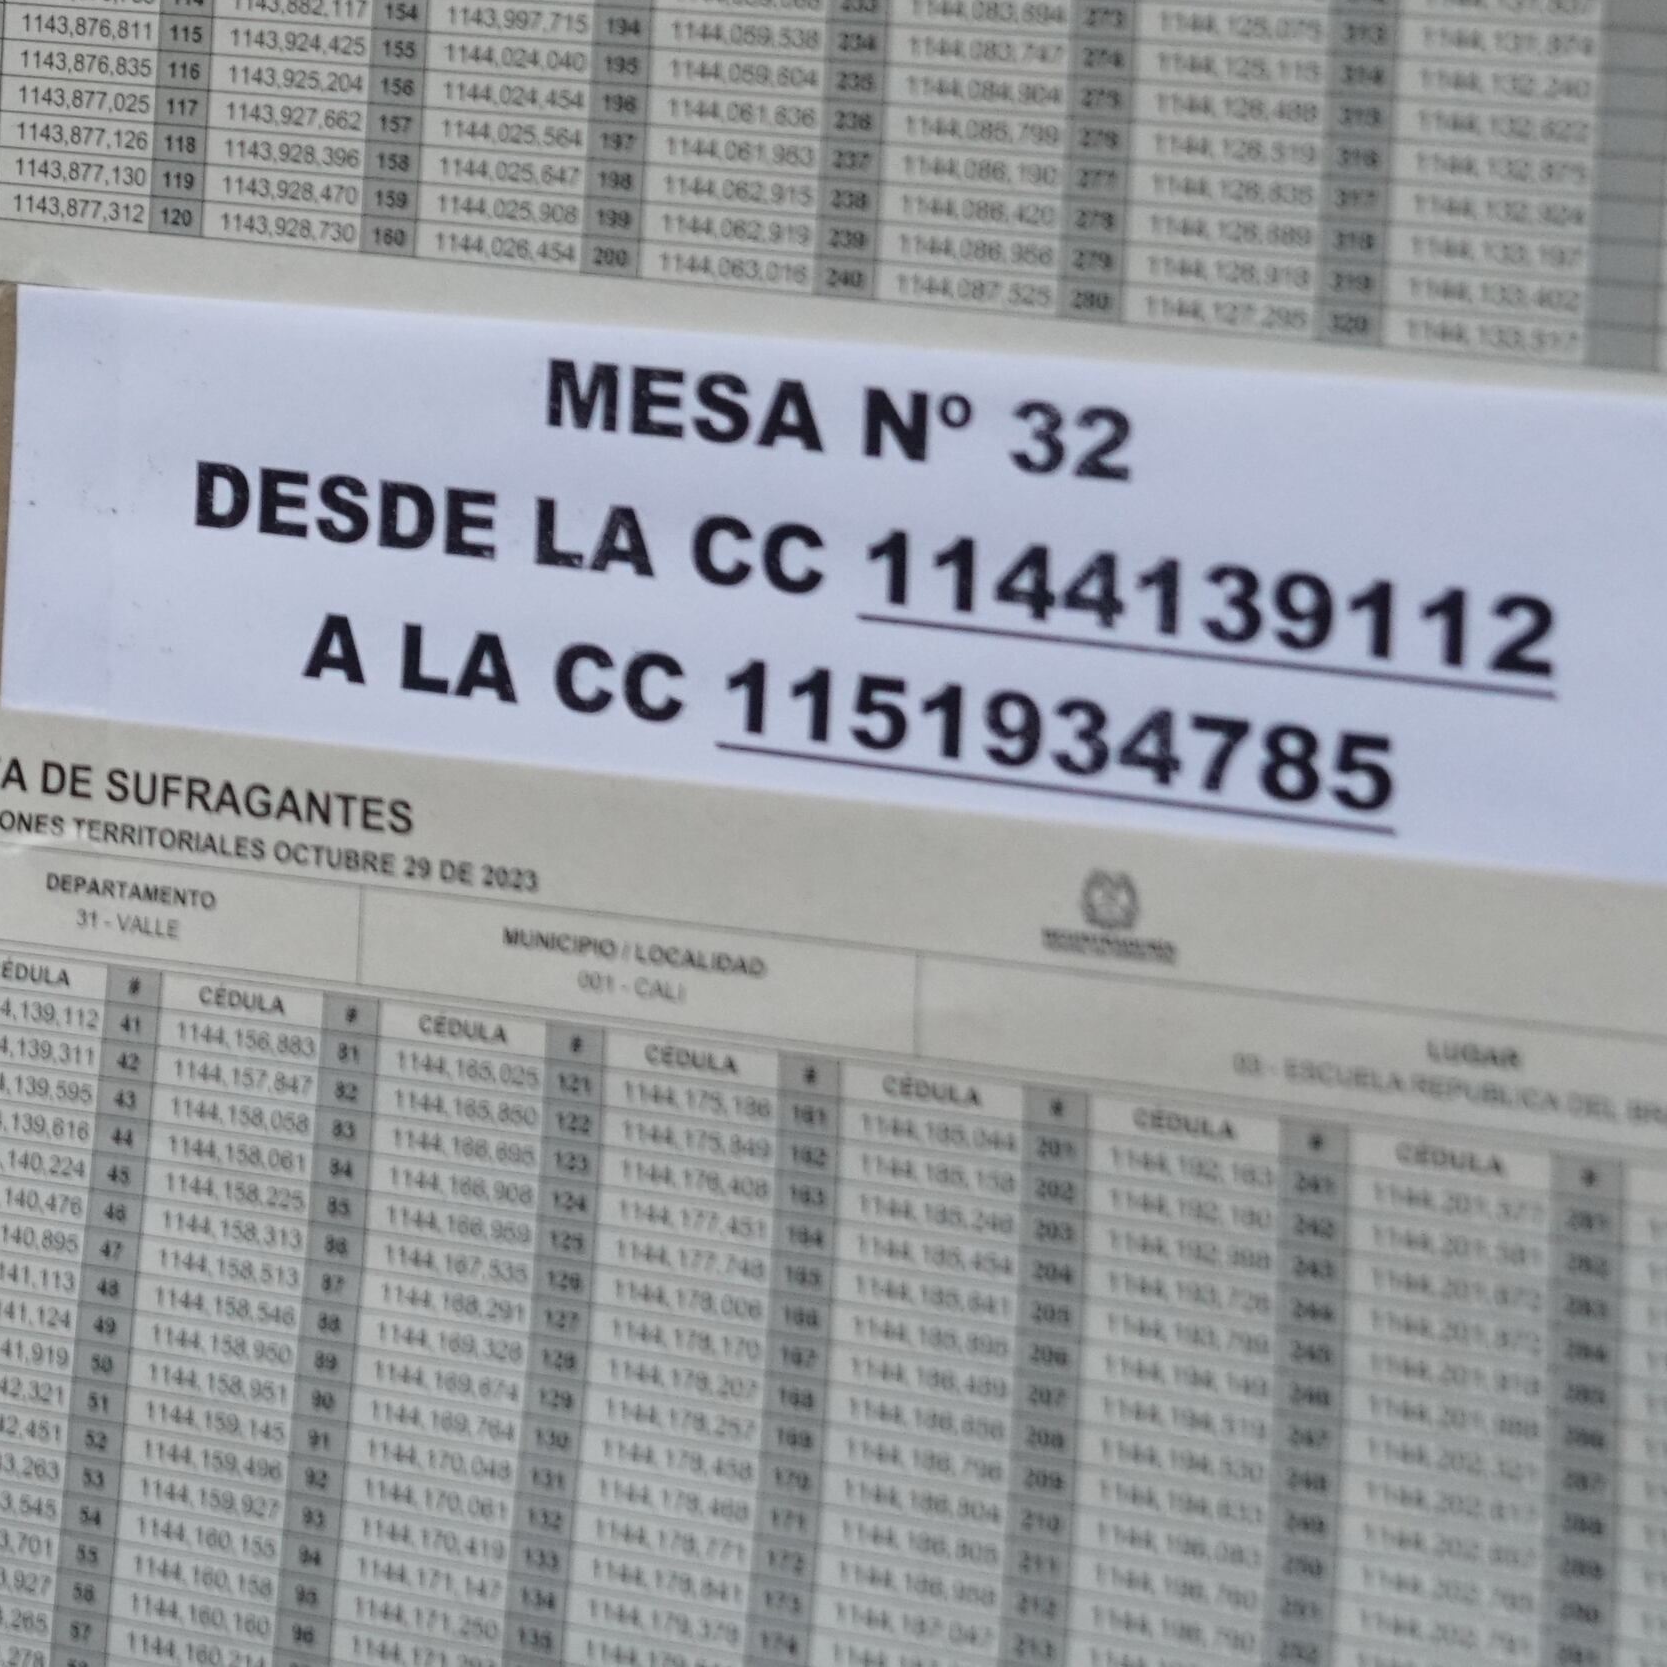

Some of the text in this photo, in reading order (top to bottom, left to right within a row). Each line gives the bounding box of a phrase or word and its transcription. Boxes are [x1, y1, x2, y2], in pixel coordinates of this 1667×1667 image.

[548, 360, 823, 452] MESA
[1013, 402, 1130, 480] 32
[196, 462, 1553, 677] DESDE LA CC 1144139112
[304, 614, 1392, 811] A LA CC 1151934785
[41, 760, 93, 801] DE
[105, 769, 414, 835] SUFRAGANTES
